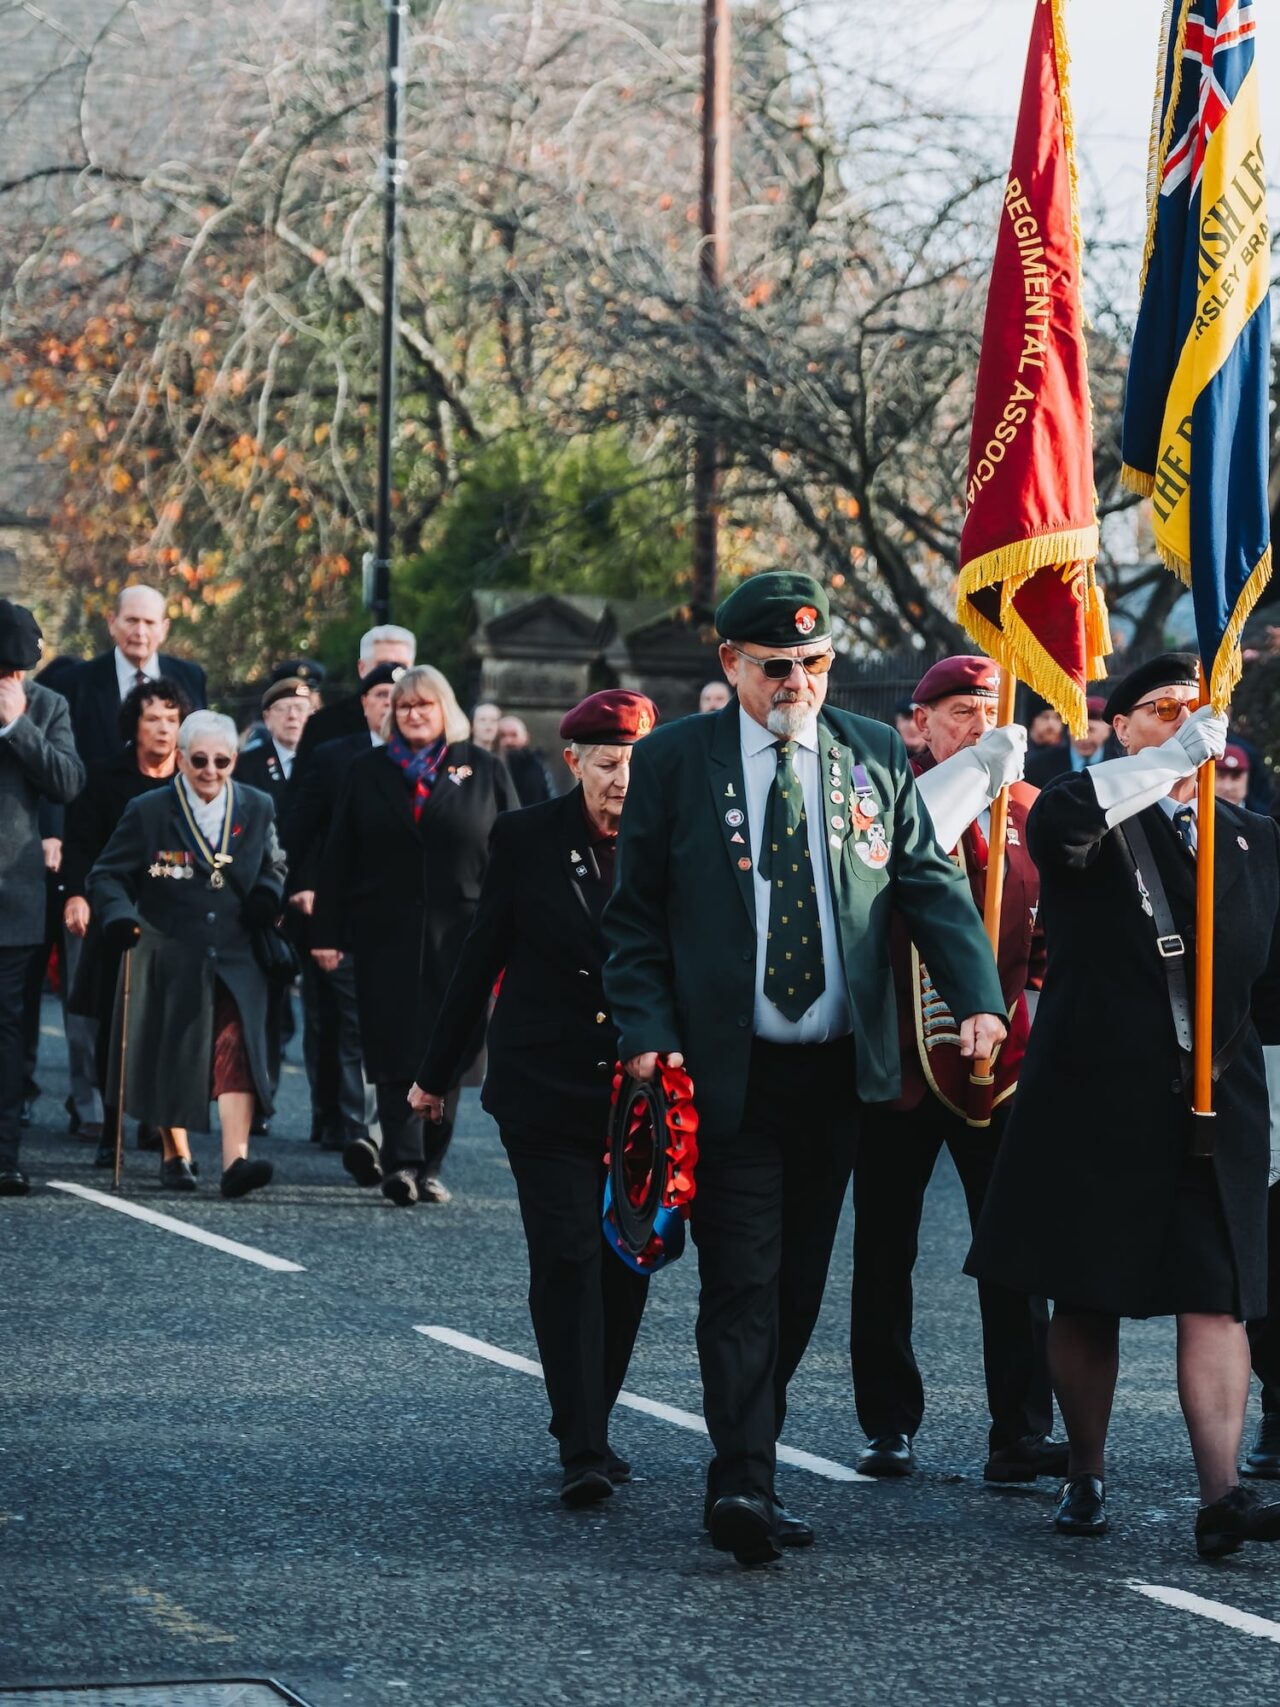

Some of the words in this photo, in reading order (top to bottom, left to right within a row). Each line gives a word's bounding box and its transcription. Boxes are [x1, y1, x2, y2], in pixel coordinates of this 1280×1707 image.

[1005, 177, 1050, 374] REGIMENTAL
[1194, 264, 1241, 340] RSLEY
[1240, 216, 1270, 267] BRA
[966, 379, 1036, 516] ASSOCIA
